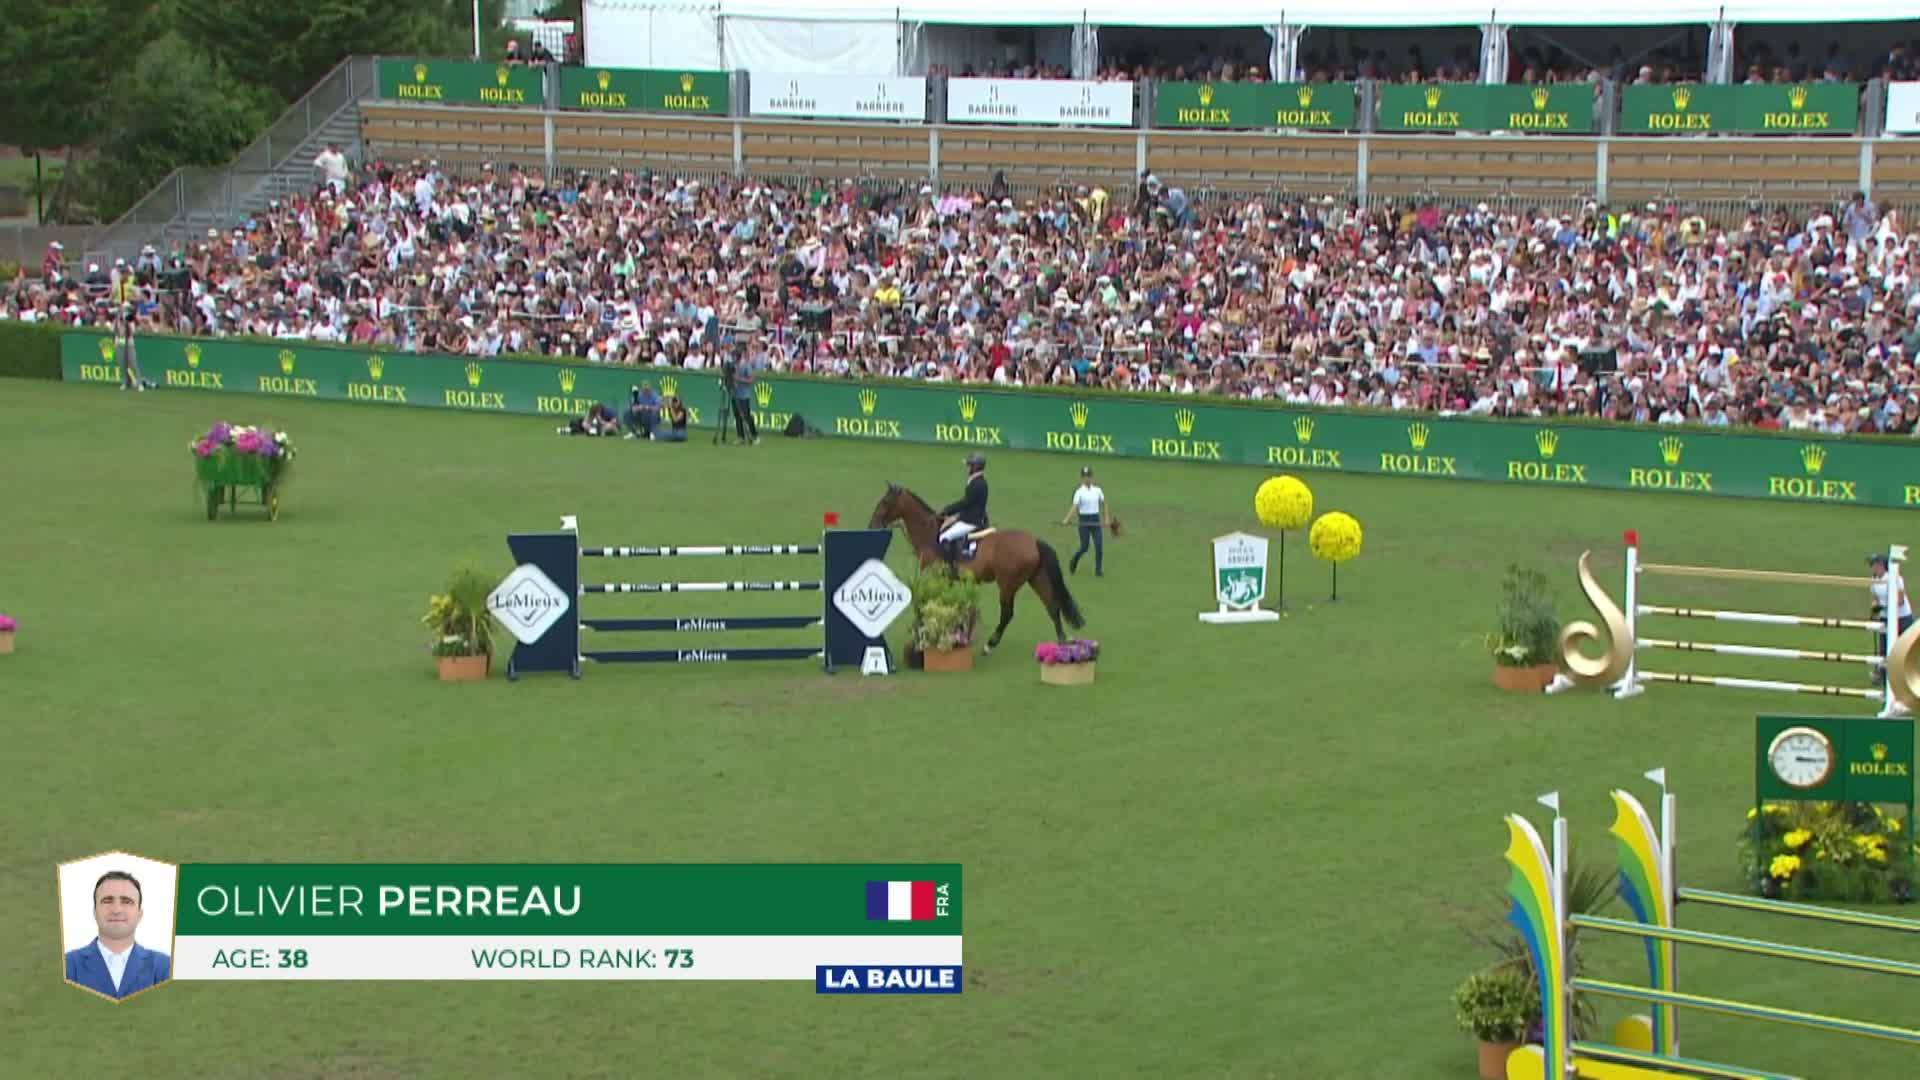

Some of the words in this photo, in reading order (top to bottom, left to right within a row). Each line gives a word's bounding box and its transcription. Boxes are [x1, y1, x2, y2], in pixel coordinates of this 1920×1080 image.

[398, 84, 442, 99] ROLEX
[479, 87, 524, 102] ROLEX
[580, 92, 626, 107] ROLEX
[664, 94, 709, 110] ROLEX
[1178, 108, 1231, 123] ROLEX
[1277, 110, 1331, 126] ROLEX
[1403, 111, 1460, 127] ROLEX
[1509, 112, 1569, 129] ROLEX
[1648, 113, 1711, 129] ROLEX
[1764, 112, 1829, 129] ROLEX
[80, 364, 137, 384] ROL
[165, 370, 224, 389] ROLEX
[259, 376, 318, 396] ROLEX
[347, 383, 408, 404] ROLEX
[444, 389, 506, 410] ROLEX
[835, 417, 902, 439] ROLEX
[935, 423, 1002, 446] ROLEX
[1046, 431, 1115, 454] ROLEX
[1151, 438, 1221, 460] ROLEX
[1267, 445, 1342, 469] ROLEX
[1380, 453, 1457, 476] ROLEX
[1508, 461, 1588, 484] ROLEX
[1630, 467, 1713, 493] ROLEX
[1769, 476, 1857, 501] ROLEX
[495, 593, 560, 608] LeMieux
[841, 588, 903, 602] LeMieux
[676, 618, 726, 631] LeMieux
[677, 650, 728, 662] LeMieux
[1850, 762, 1908, 776] ROLEX
